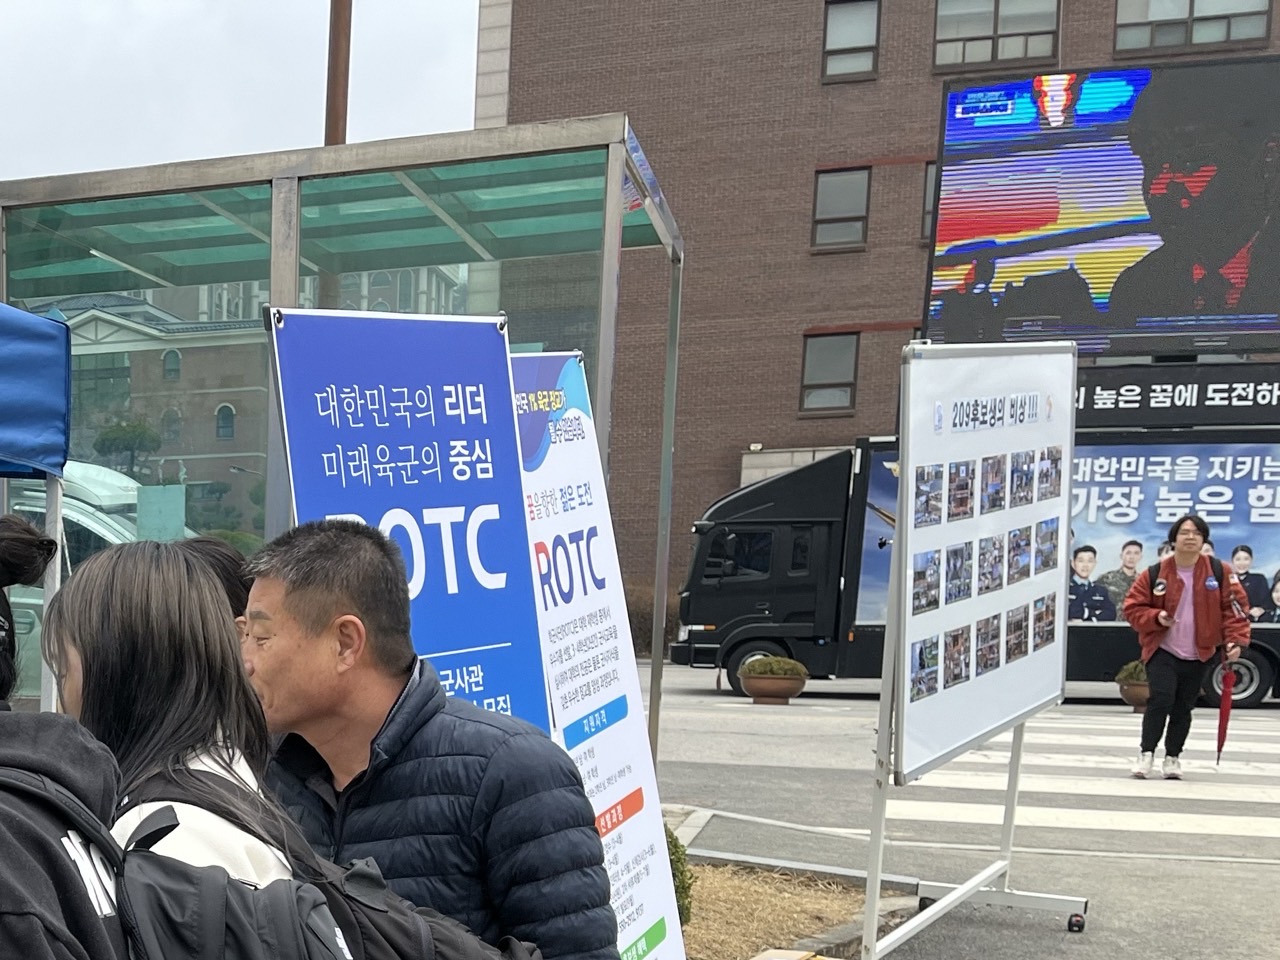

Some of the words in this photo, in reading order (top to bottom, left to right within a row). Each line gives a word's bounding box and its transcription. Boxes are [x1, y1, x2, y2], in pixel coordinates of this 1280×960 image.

[314, 384, 435, 429] 대한민국의
[443, 383, 488, 425] 리더
[952, 397, 1006, 429] 209후보생의
[1093, 385, 1142, 409] 높은
[1149, 384, 1198, 408] 꿈에
[1204, 383, 1280, 407] 도전하
[321, 441, 442, 488] 미래육군의
[448, 438, 494, 481] 중심
[1073, 456, 1200, 482] 대한민국을
[1206, 456, 1280, 481] 지키는
[577, 481, 593, 506] 도전
[1071, 486, 1144, 524] 가장
[1155, 485, 1234, 523] 높은
[325, 504, 507, 600] OTC
[534, 525, 606, 611] ROTC
[439, 664, 484, 697] 군사관
